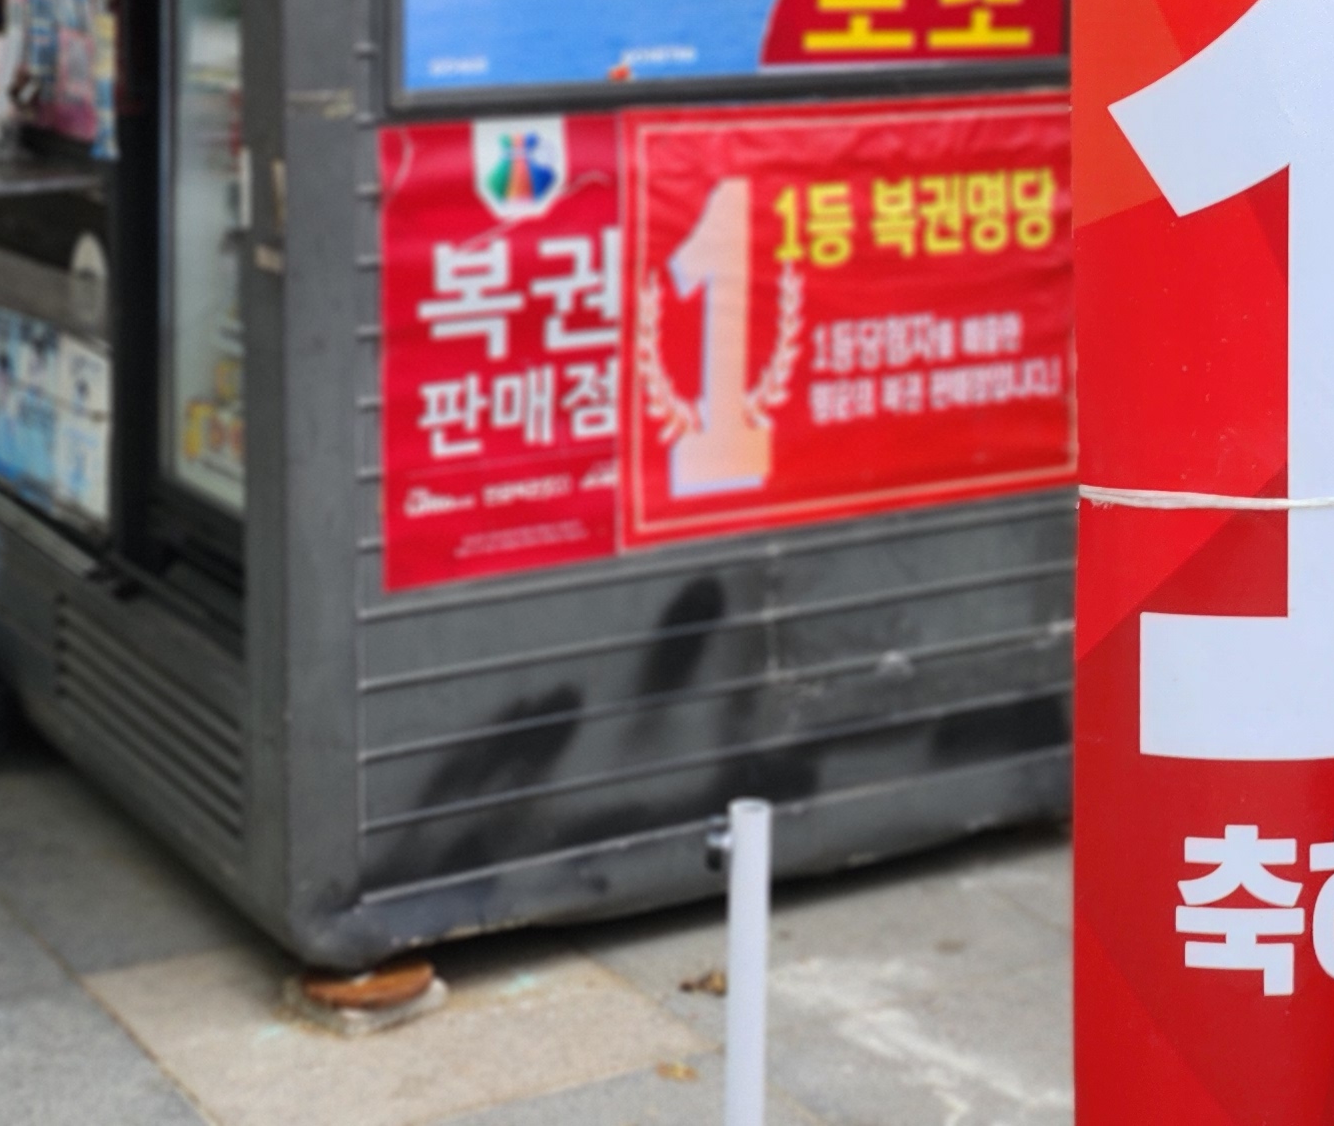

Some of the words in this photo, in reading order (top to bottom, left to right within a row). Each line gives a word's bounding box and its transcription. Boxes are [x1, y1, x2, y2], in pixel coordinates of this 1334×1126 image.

[773, 182, 854, 266] 1등
[871, 167, 1056, 257] 복권명당
[417, 227, 619, 360] 복권
[417, 357, 619, 459] 판매점
